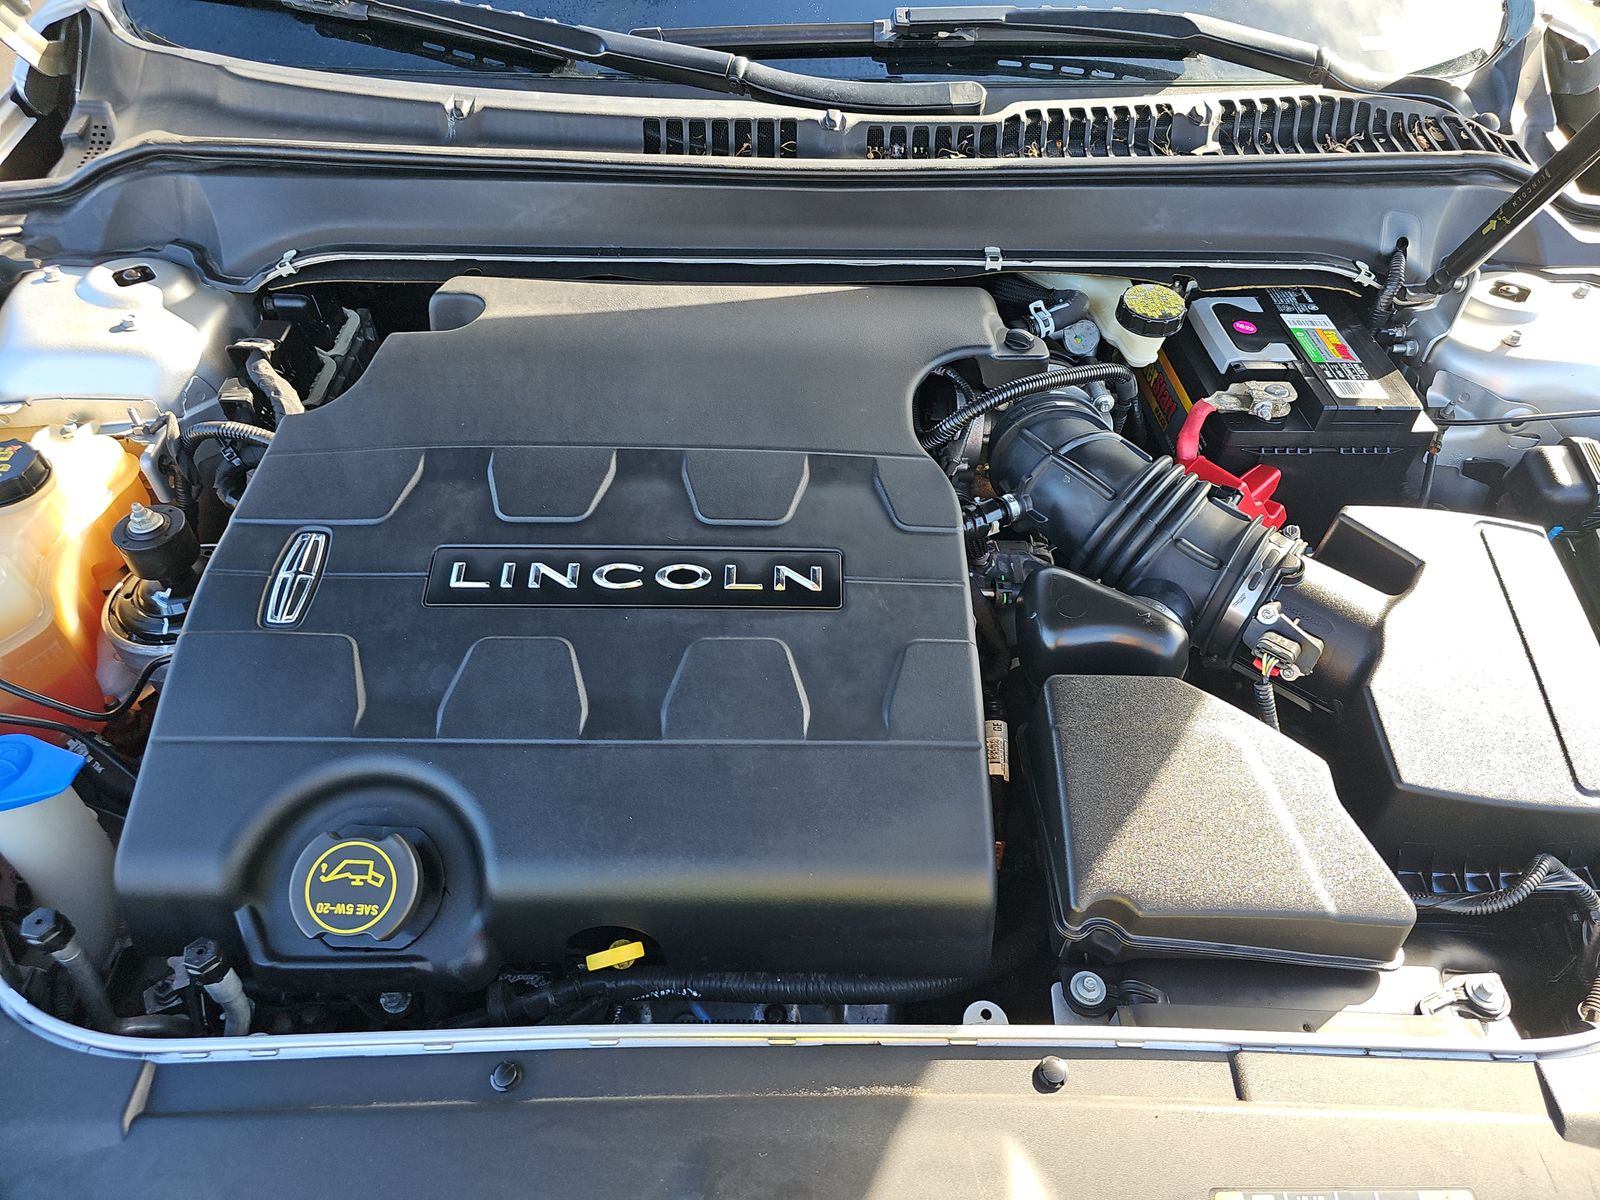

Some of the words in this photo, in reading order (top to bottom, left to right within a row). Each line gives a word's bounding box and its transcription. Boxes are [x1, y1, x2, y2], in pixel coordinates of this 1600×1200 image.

[1511, 173, 1547, 208] LINCOLN
[448, 561, 823, 592] LINCOLN
[315, 902, 355, 915] 5W-20
[355, 903, 379, 916] SAE
